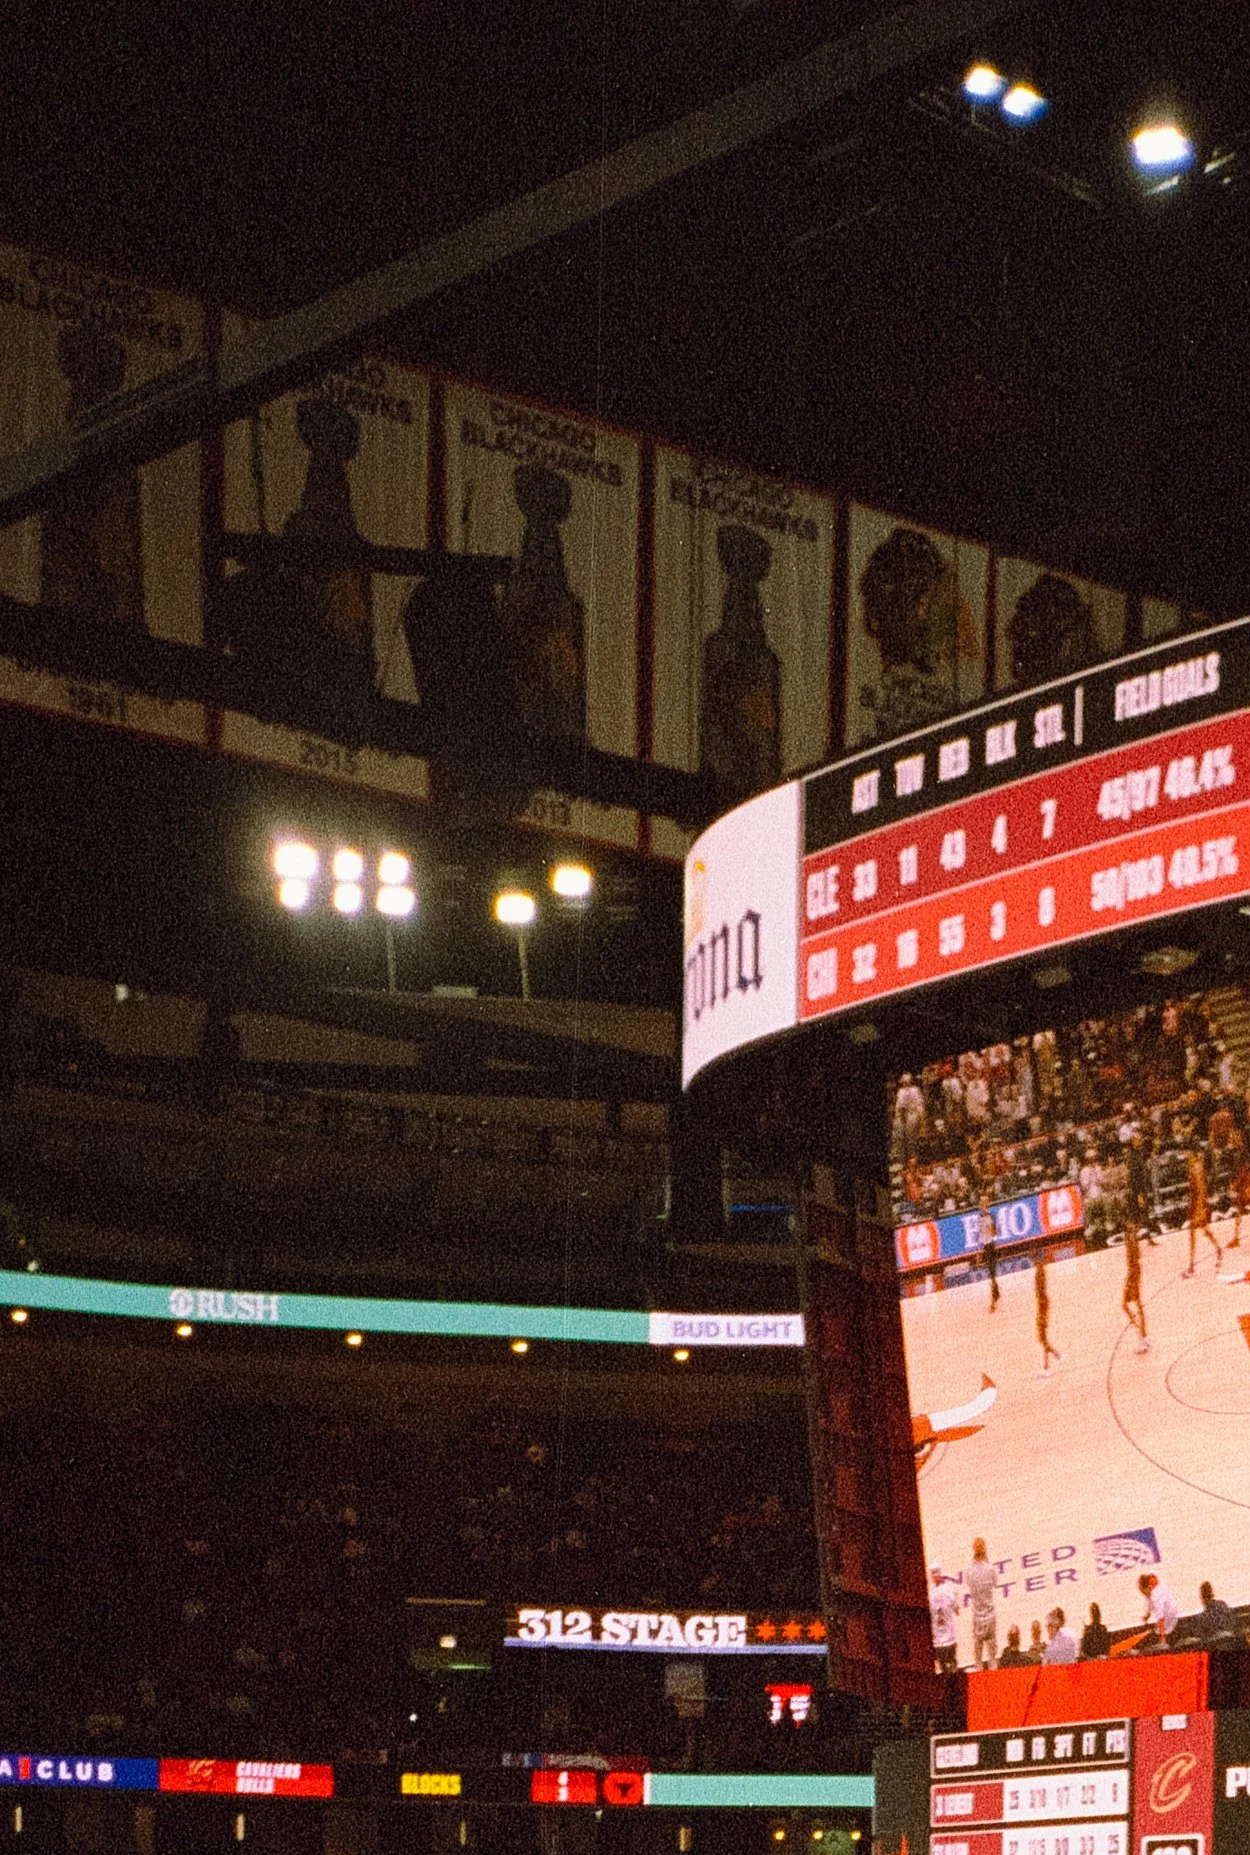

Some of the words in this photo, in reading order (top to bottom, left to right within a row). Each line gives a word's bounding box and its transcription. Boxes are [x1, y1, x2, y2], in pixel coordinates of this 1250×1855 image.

[1113, 672, 1162, 721] FIELD
[197, 1290, 280, 1322] RUSH
[672, 1318, 719, 1341] BUD
[725, 1318, 793, 1343] LIGHT
[518, 1606, 592, 1644] 312
[601, 1611, 748, 1649] STAGE
[38, 1761, 112, 1781] CLUB
[237, 1762, 301, 1778] CAVALIERS
[401, 1773, 462, 1796] BLOCKS
